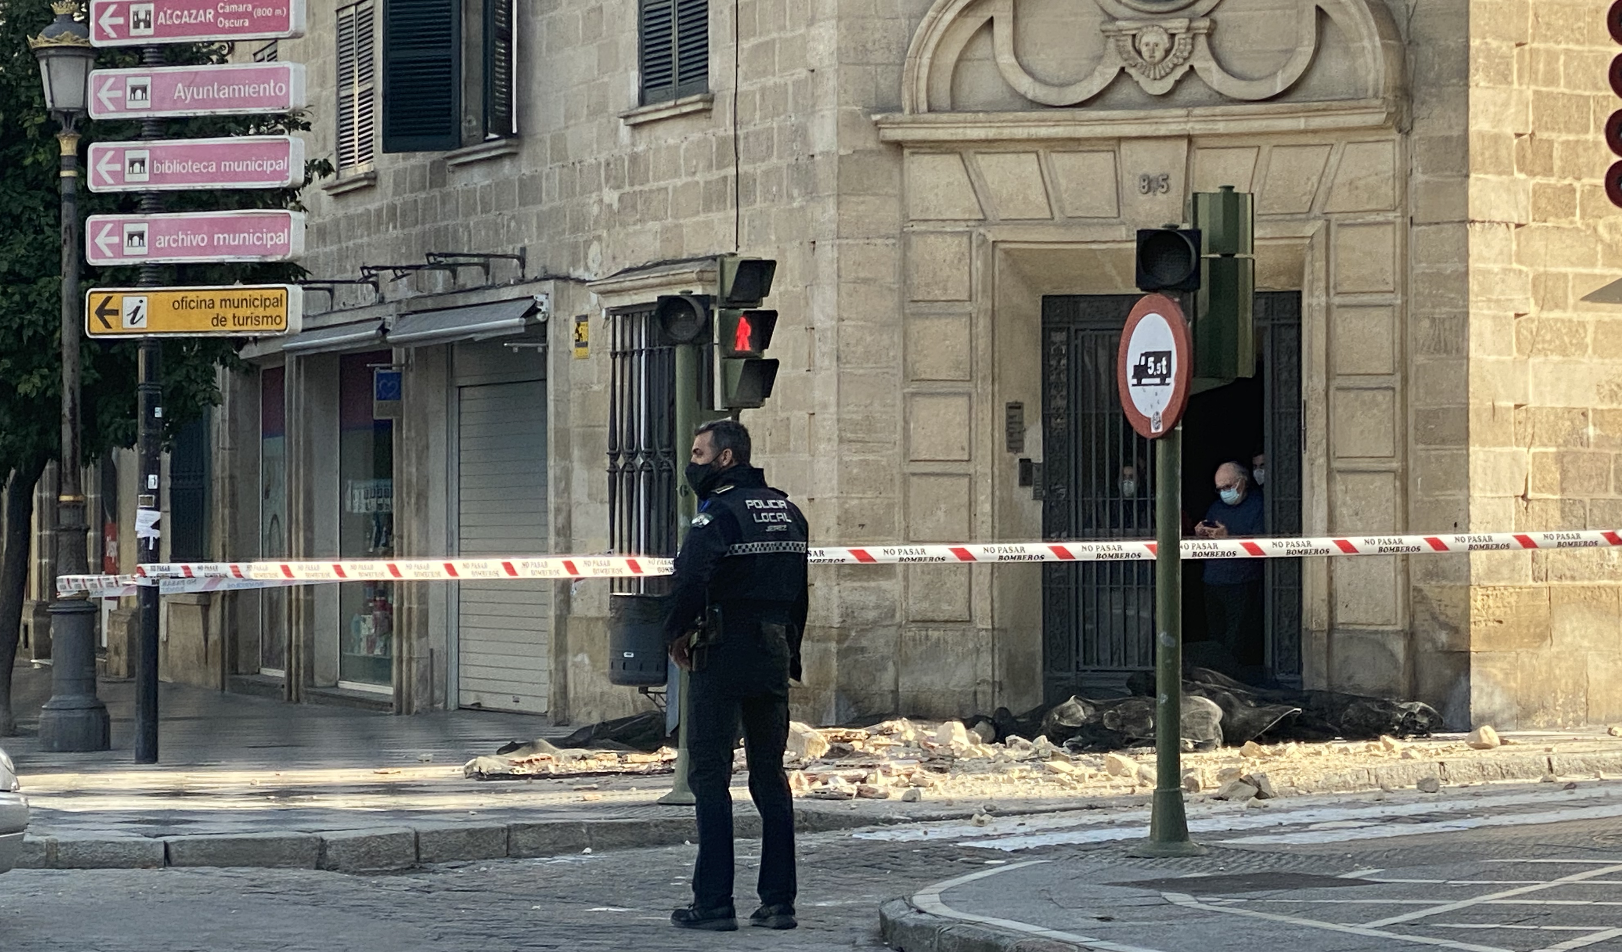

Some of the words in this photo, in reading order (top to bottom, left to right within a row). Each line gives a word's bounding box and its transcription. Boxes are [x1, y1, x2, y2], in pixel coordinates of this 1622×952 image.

[253, 7, 273, 19] (800
[217, 17, 249, 28] Oscura
[174, 79, 286, 103] Ayuntamiento
[153, 158, 216, 174] biblioteca
[221, 156, 288, 177] municipal
[155, 231, 207, 248] archivo
[213, 228, 288, 249] municipal
[172, 295, 215, 311] oficina
[219, 293, 283, 311] municipal
[211, 313, 227, 327] de
[232, 312, 283, 327] turismo
[753, 512, 792, 523] LOCAL
[1467, 535, 1493, 543] PASAR
[1543, 533, 1555, 541] NO
[1556, 533, 1582, 541] PASAR
[1285, 540, 1312, 548] PASAR
[1364, 538, 1376, 546] NO
[1377, 538, 1404, 546] PASAR
[1556, 540, 1599, 548] BOMBEROS
[983, 546, 995, 554] NO
[998, 546, 1026, 554] PASAR
[1081, 544, 1094, 552] NO
[1095, 544, 1123, 552] PASAR
[1191, 542, 1219, 551] PASAR
[1378, 545, 1421, 553] BOMBEROS
[1468, 542, 1511, 551] BOMBEROS
[883, 548, 895, 556] NO
[898, 547, 927, 556] PASAR
[1192, 550, 1238, 558] BOMBEROS
[1285, 548, 1330, 556] BOMBEROS
[1095, 552, 1142, 560] BOMBEROS
